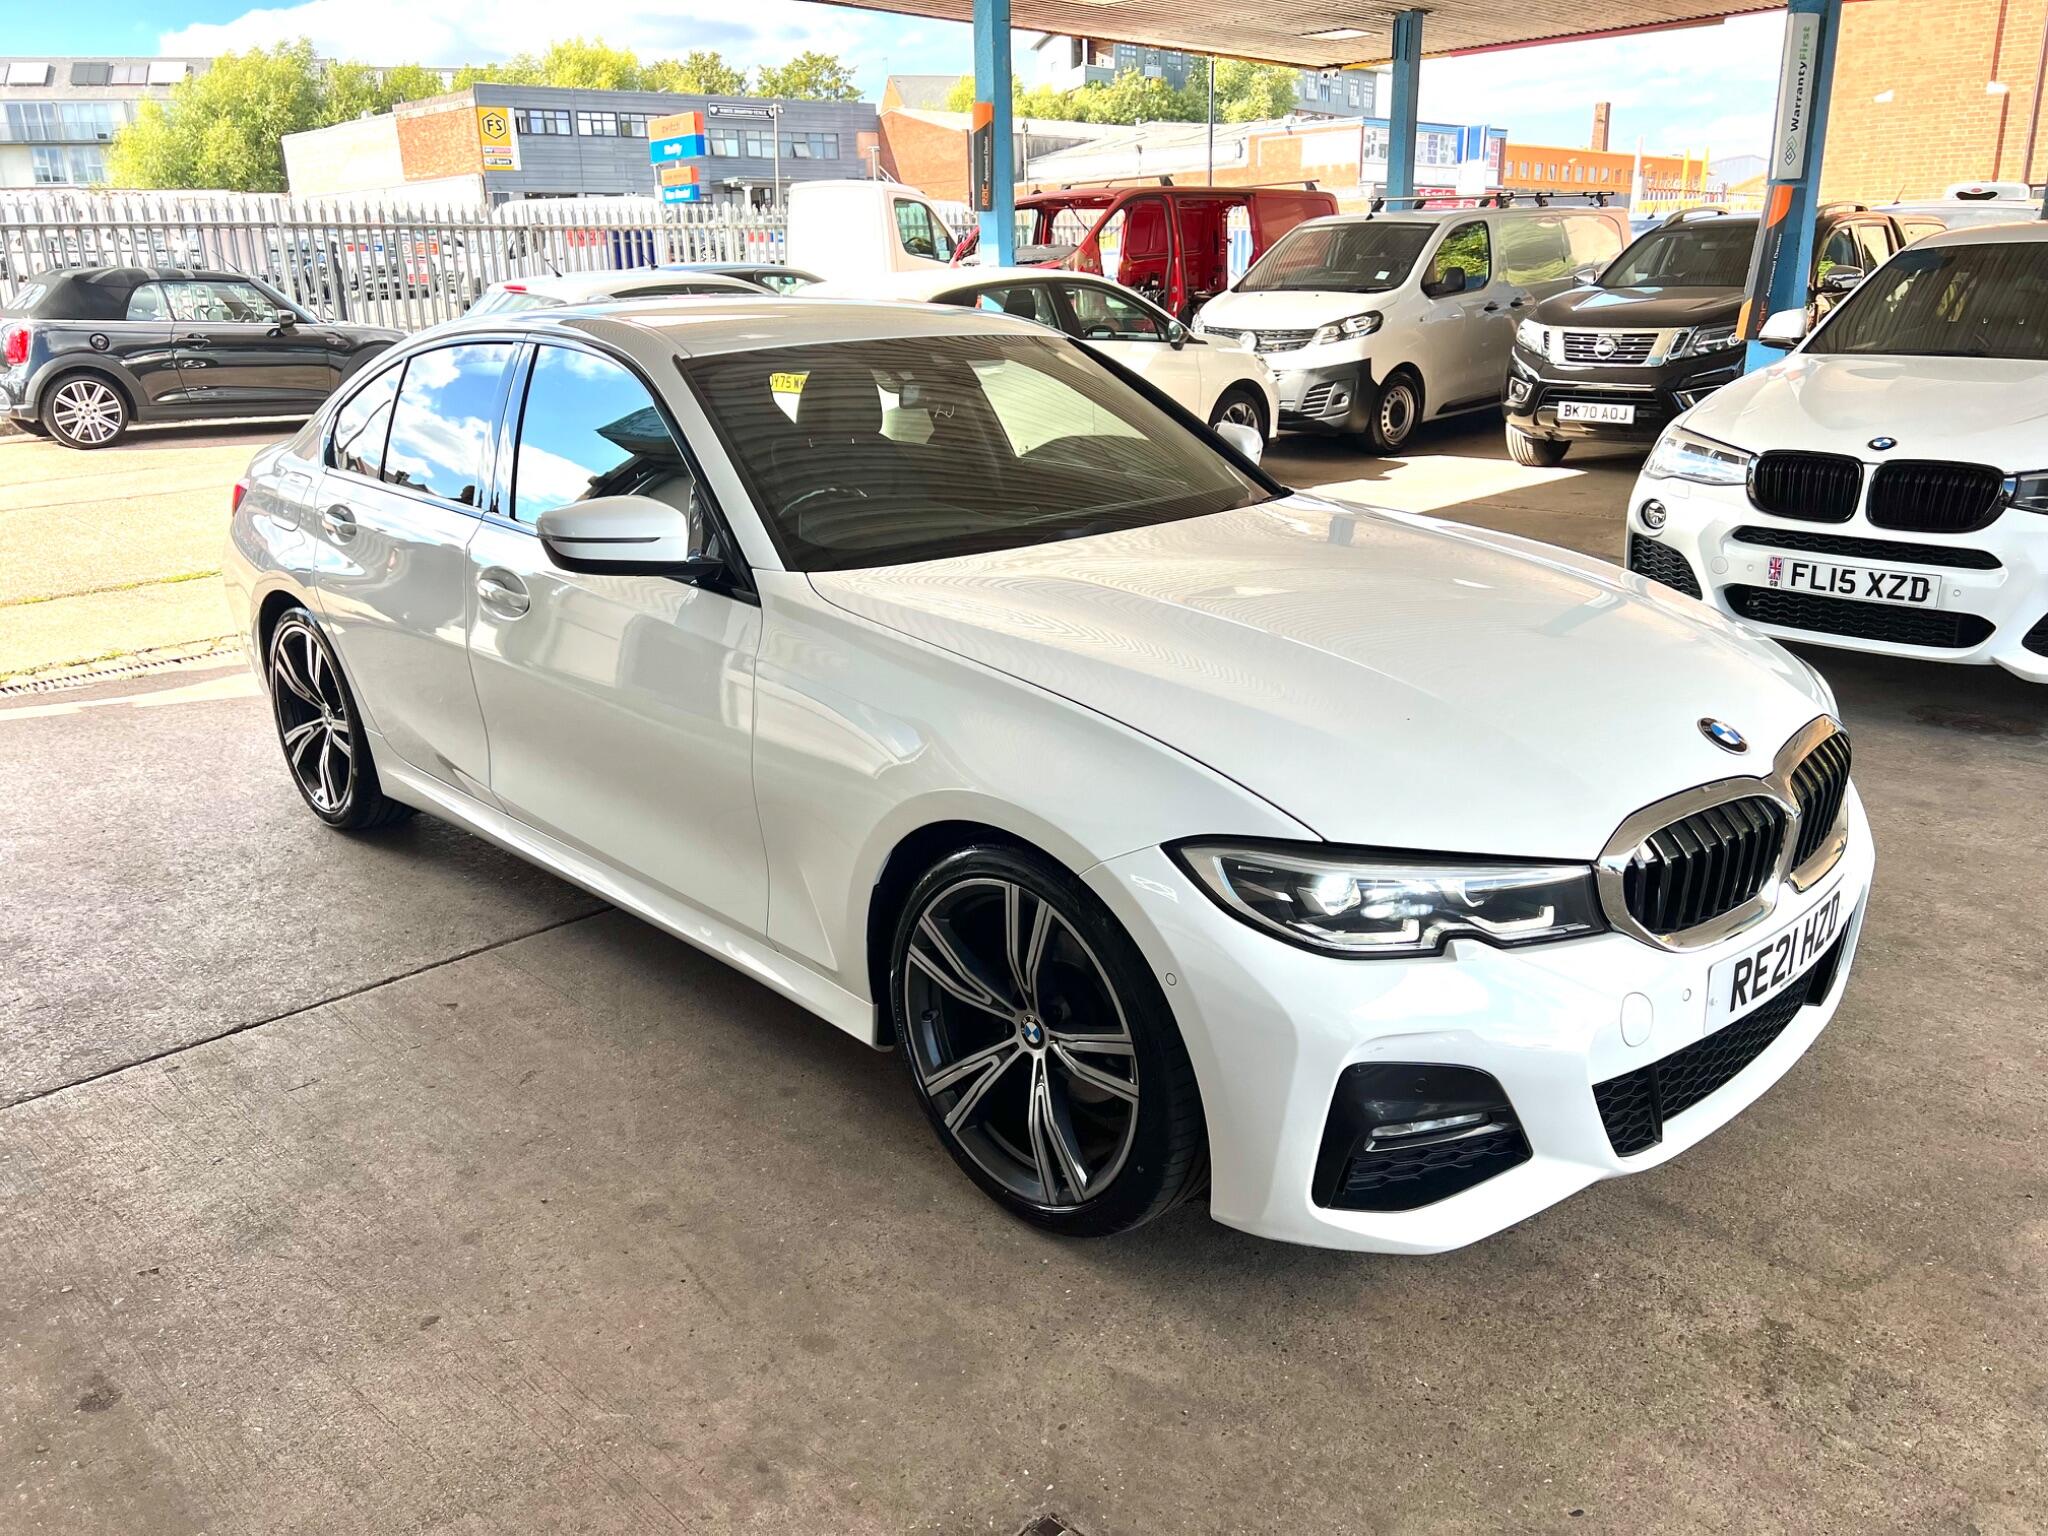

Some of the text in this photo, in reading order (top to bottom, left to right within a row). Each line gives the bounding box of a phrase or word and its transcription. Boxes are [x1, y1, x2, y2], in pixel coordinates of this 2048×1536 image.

[1790, 26, 1811, 132] WarrantyFirst
[486, 119, 502, 132] FS
[1564, 404, 1598, 419] BK70
[1790, 562, 1931, 603] FL15 XZD
[1729, 890, 1841, 1013] RE21 HZD
